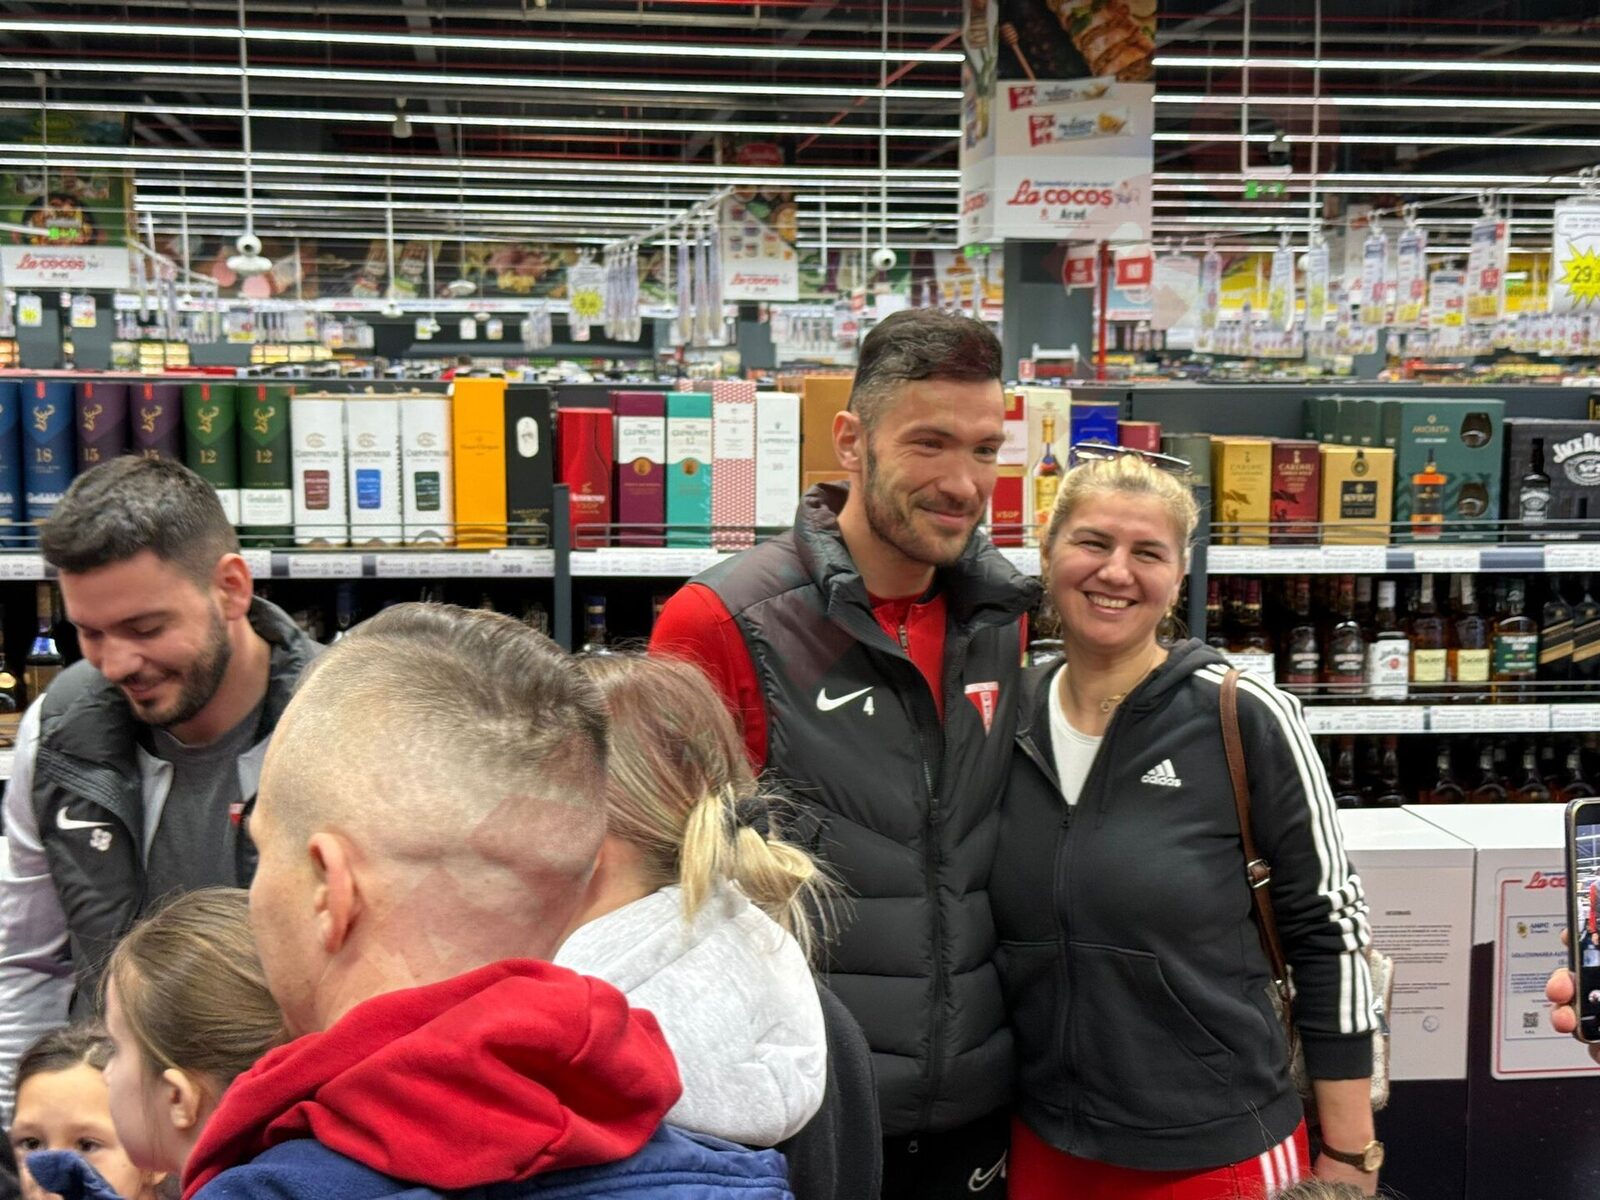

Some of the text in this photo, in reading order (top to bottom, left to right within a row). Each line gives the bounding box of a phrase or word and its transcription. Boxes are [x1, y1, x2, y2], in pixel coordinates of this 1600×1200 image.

[1007, 178, 1040, 205] La
[1060, 209, 1086, 219] Arad
[1572, 265, 1592, 283] 29
[36, 448, 53, 463] 18
[84, 447, 100, 462] 15
[200, 449, 217, 464] 12
[256, 449, 273, 464] 12
[863, 696, 875, 716] 4
[1140, 774, 1182, 788] adidas
